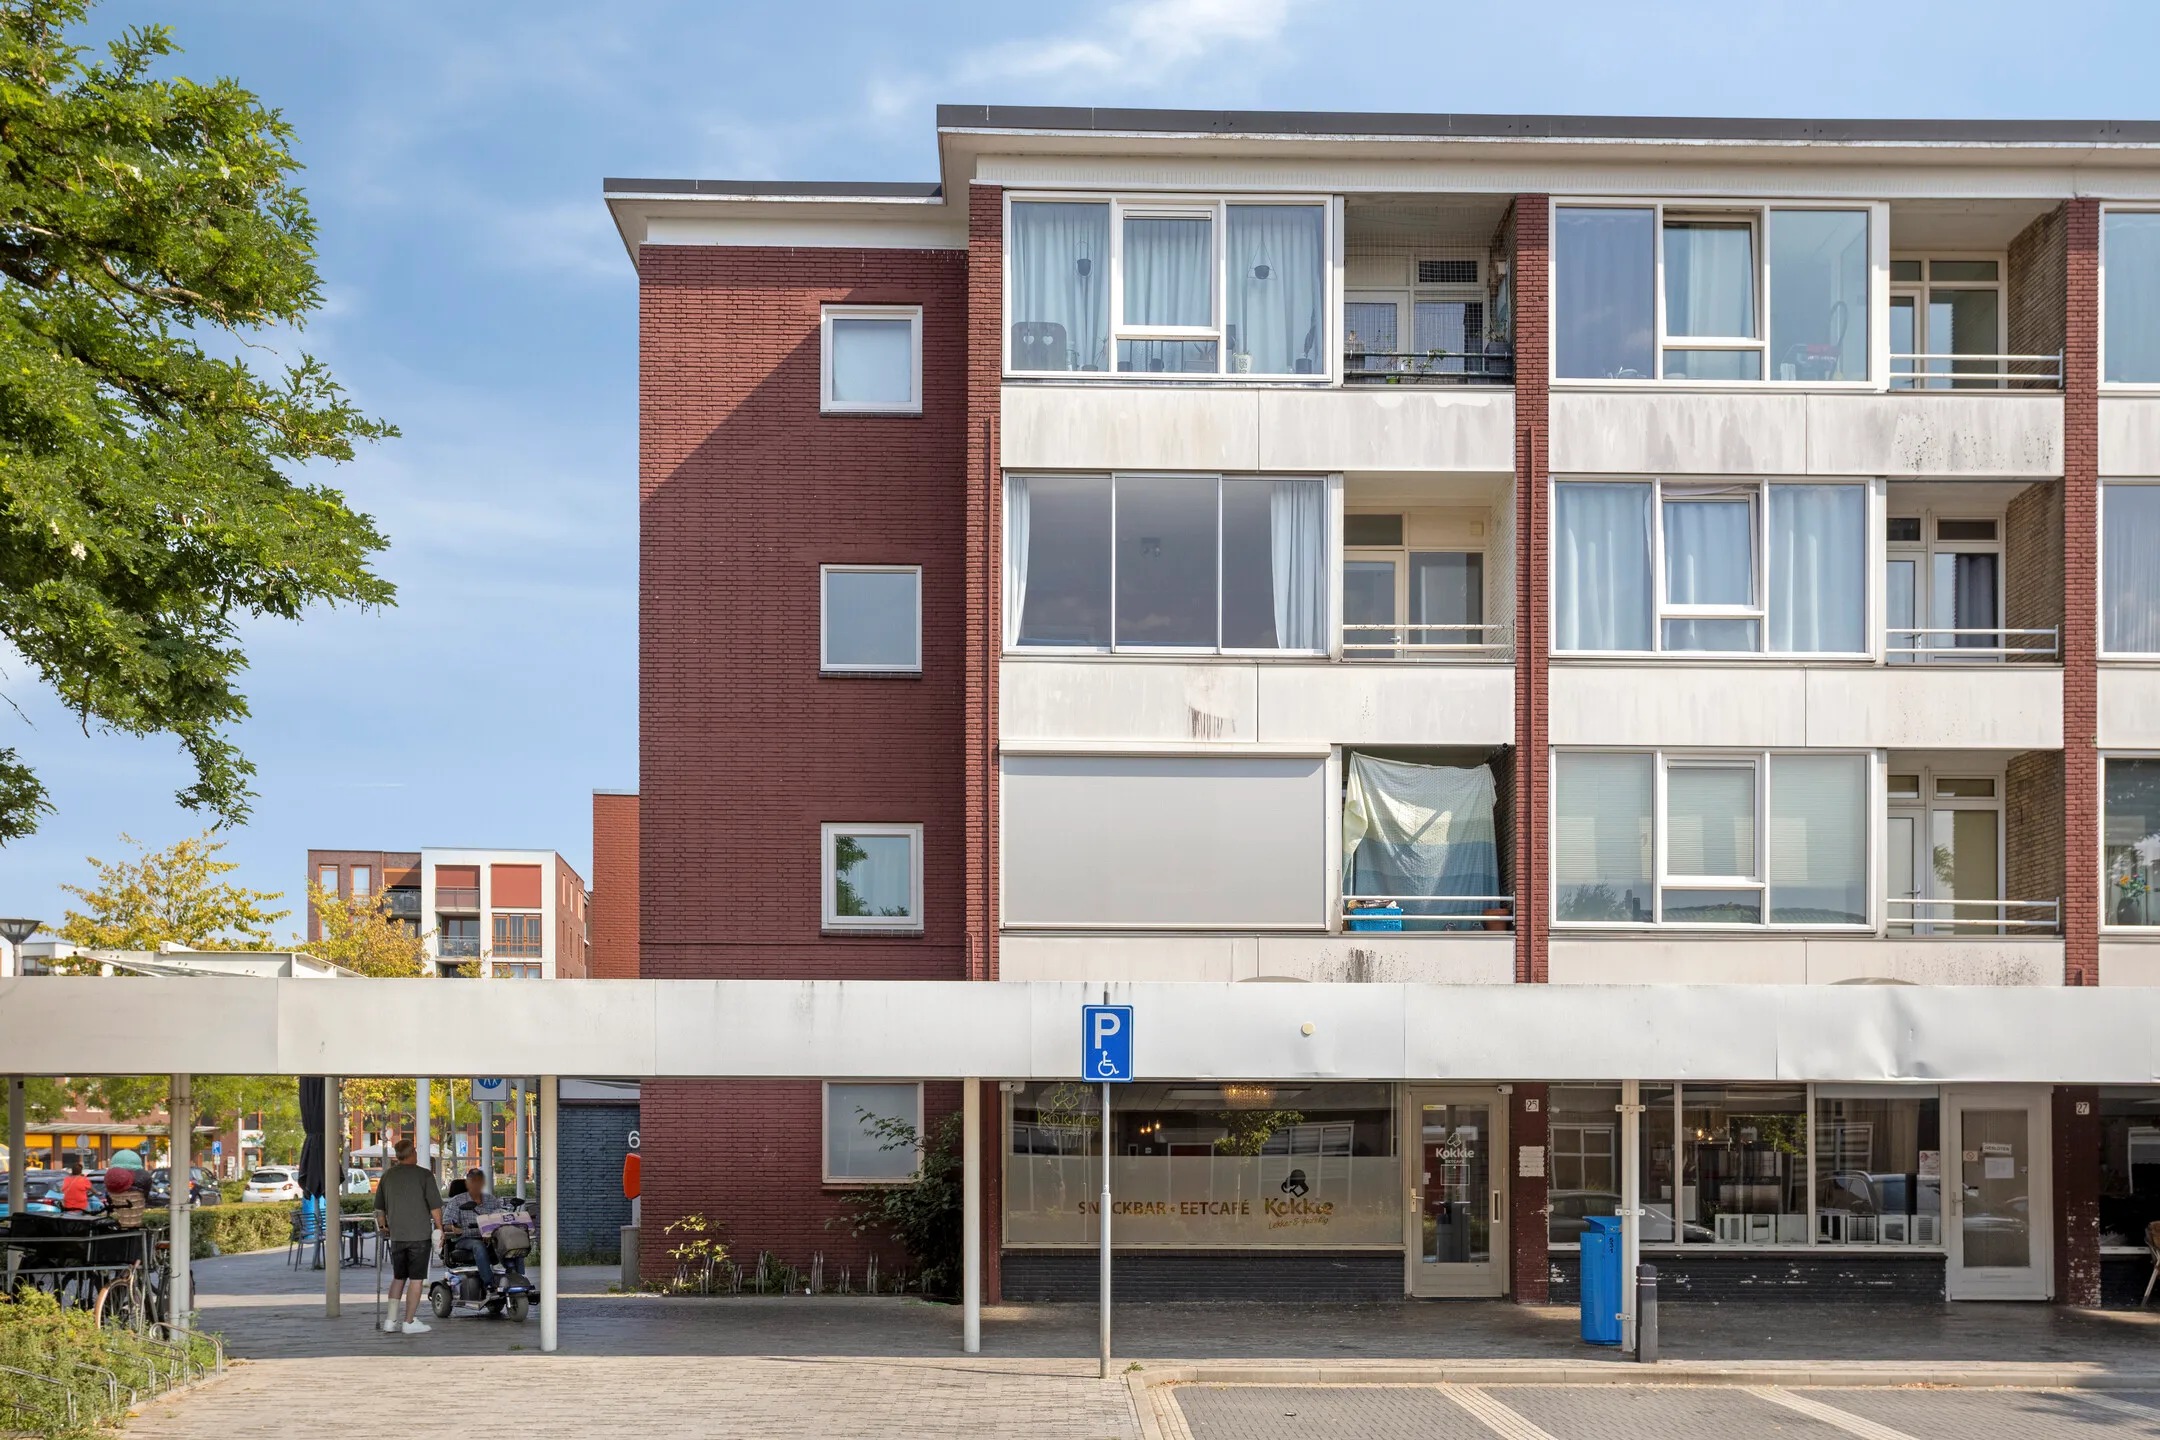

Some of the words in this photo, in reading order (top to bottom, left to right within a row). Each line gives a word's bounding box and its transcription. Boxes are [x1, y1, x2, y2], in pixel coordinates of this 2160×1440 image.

[1094, 1012, 1121, 1049] P
[1526, 1100, 1538, 1111] 25
[2077, 1103, 2088, 1114] 27
[628, 1131, 640, 1148] 6
[1435, 1147, 1475, 1159] Kokkie
[1078, 1201, 1166, 1215] SNCKBAR
[1180, 1199, 1250, 1215] EETCAFÉ
